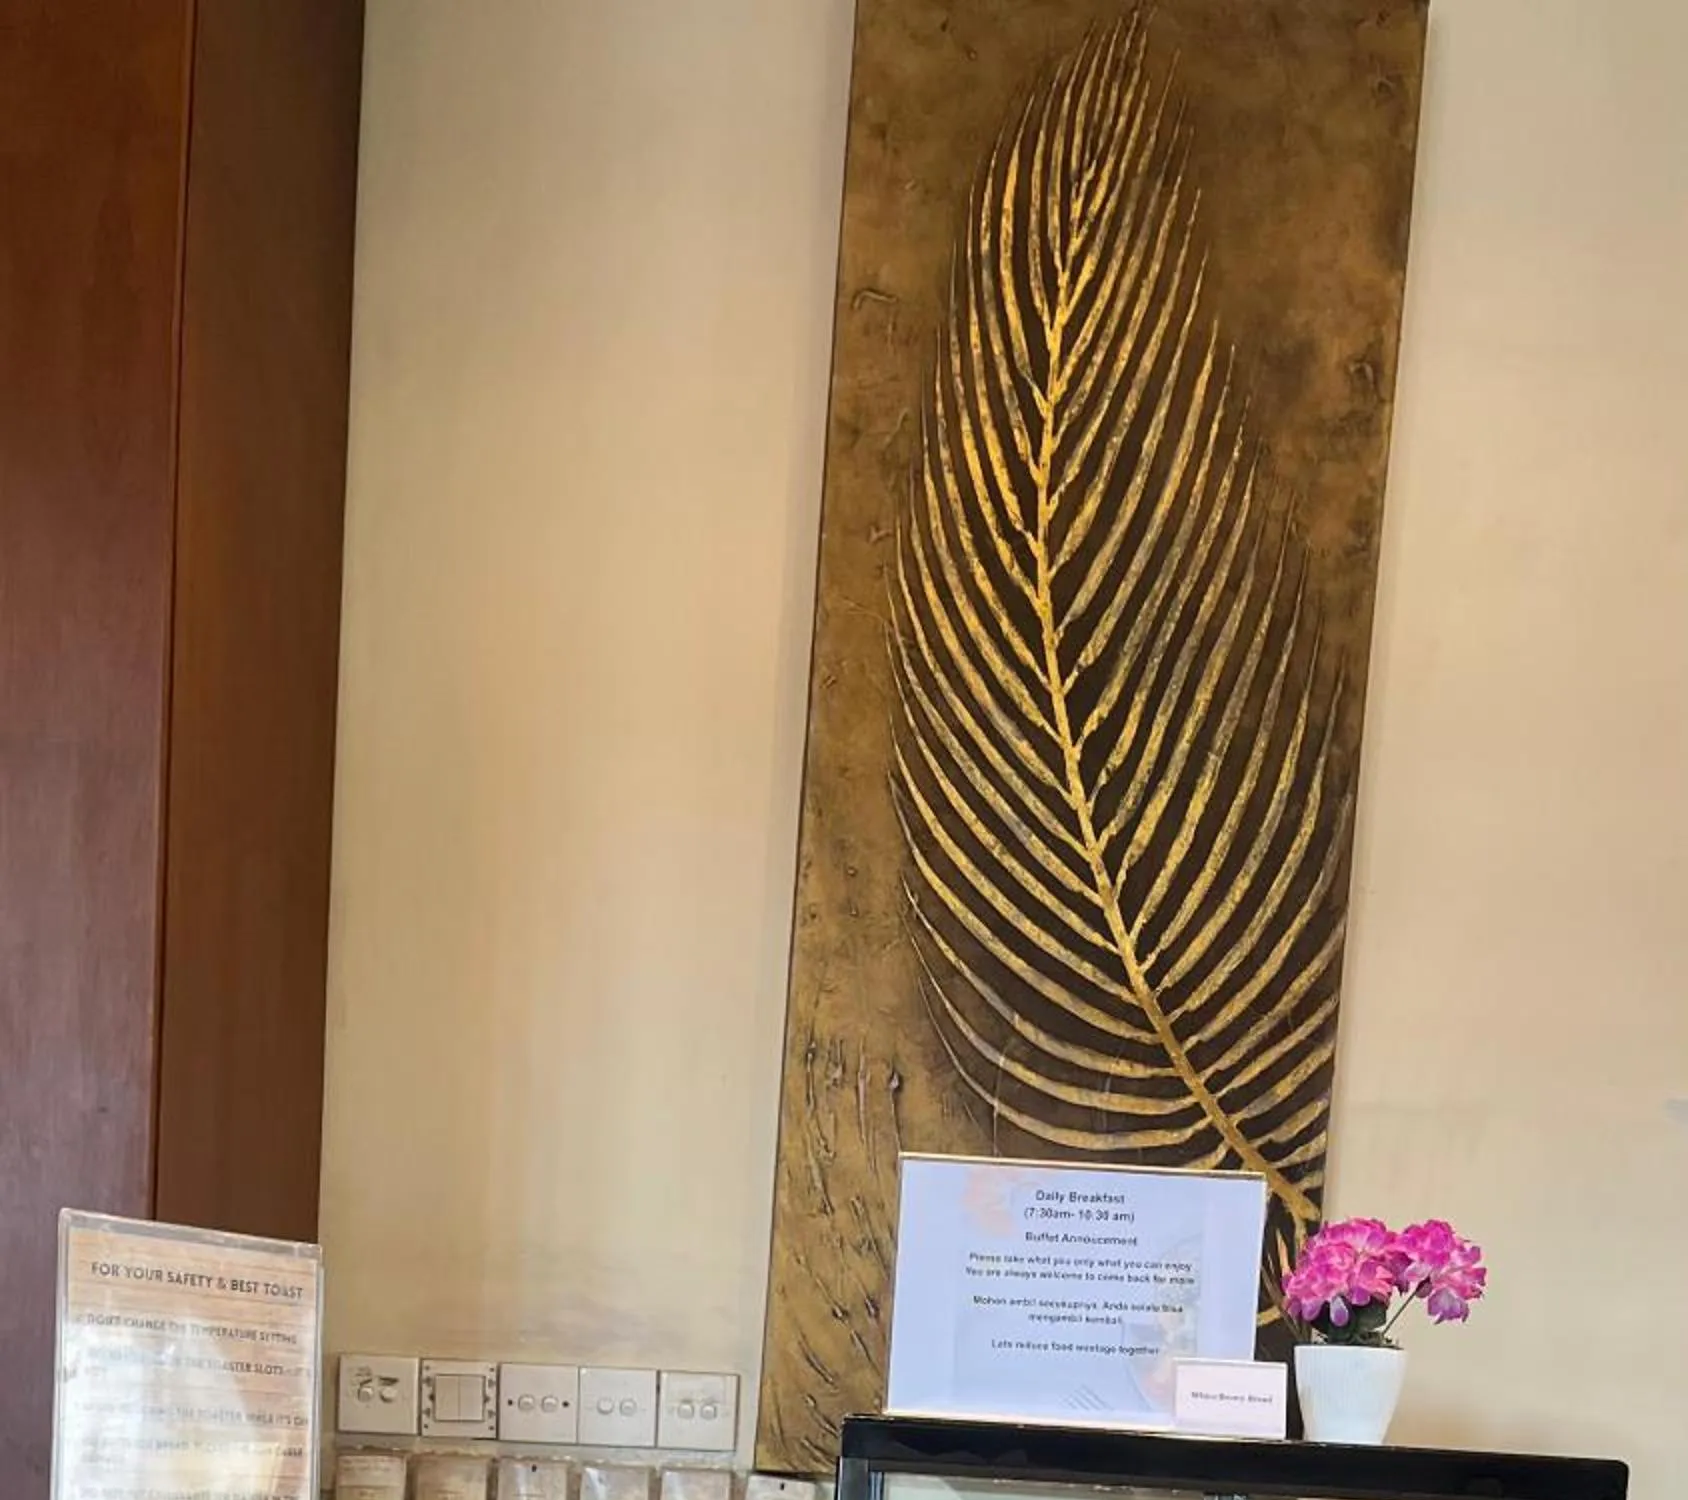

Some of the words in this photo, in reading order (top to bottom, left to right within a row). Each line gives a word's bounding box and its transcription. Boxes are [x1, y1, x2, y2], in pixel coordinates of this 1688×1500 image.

[1036, 1190, 1064, 1203] Daily
[1069, 1191, 1125, 1204] Breakfast
[1025, 1231, 1059, 1243] Buffet
[969, 1252, 1001, 1263] Please
[1003, 1254, 1025, 1263] take
[1027, 1255, 1051, 1265] what
[1053, 1258, 1071, 1267] you
[1074, 1259, 1096, 1268] only
[1098, 1259, 1121, 1267] what
[1123, 1260, 1142, 1270] you
[1143, 1261, 1163, 1269] can
[91, 1262, 119, 1277] FOR
[125, 1265, 163, 1281] YOUR
[167, 1271, 213, 1289] SAFETY
[217, 1278, 226, 1290] &
[230, 1279, 259, 1293] BEST
[263, 1283, 304, 1299] TOAST
[965, 1266, 983, 1276] You
[1004, 1269, 1037, 1280] always
[1039, 1271, 1083, 1280] welcome
[1085, 1272, 1095, 1280] to
[1097, 1273, 1124, 1281] come
[1127, 1273, 1150, 1282] back
[1153, 1274, 1166, 1282] for
[1169, 1276, 1195, 1284] more
[973, 1295, 1007, 1305] Mohon
[991, 1339, 1013, 1349] Lets
[1015, 1340, 1049, 1351] reduce
[1051, 1340, 1073, 1351] food
